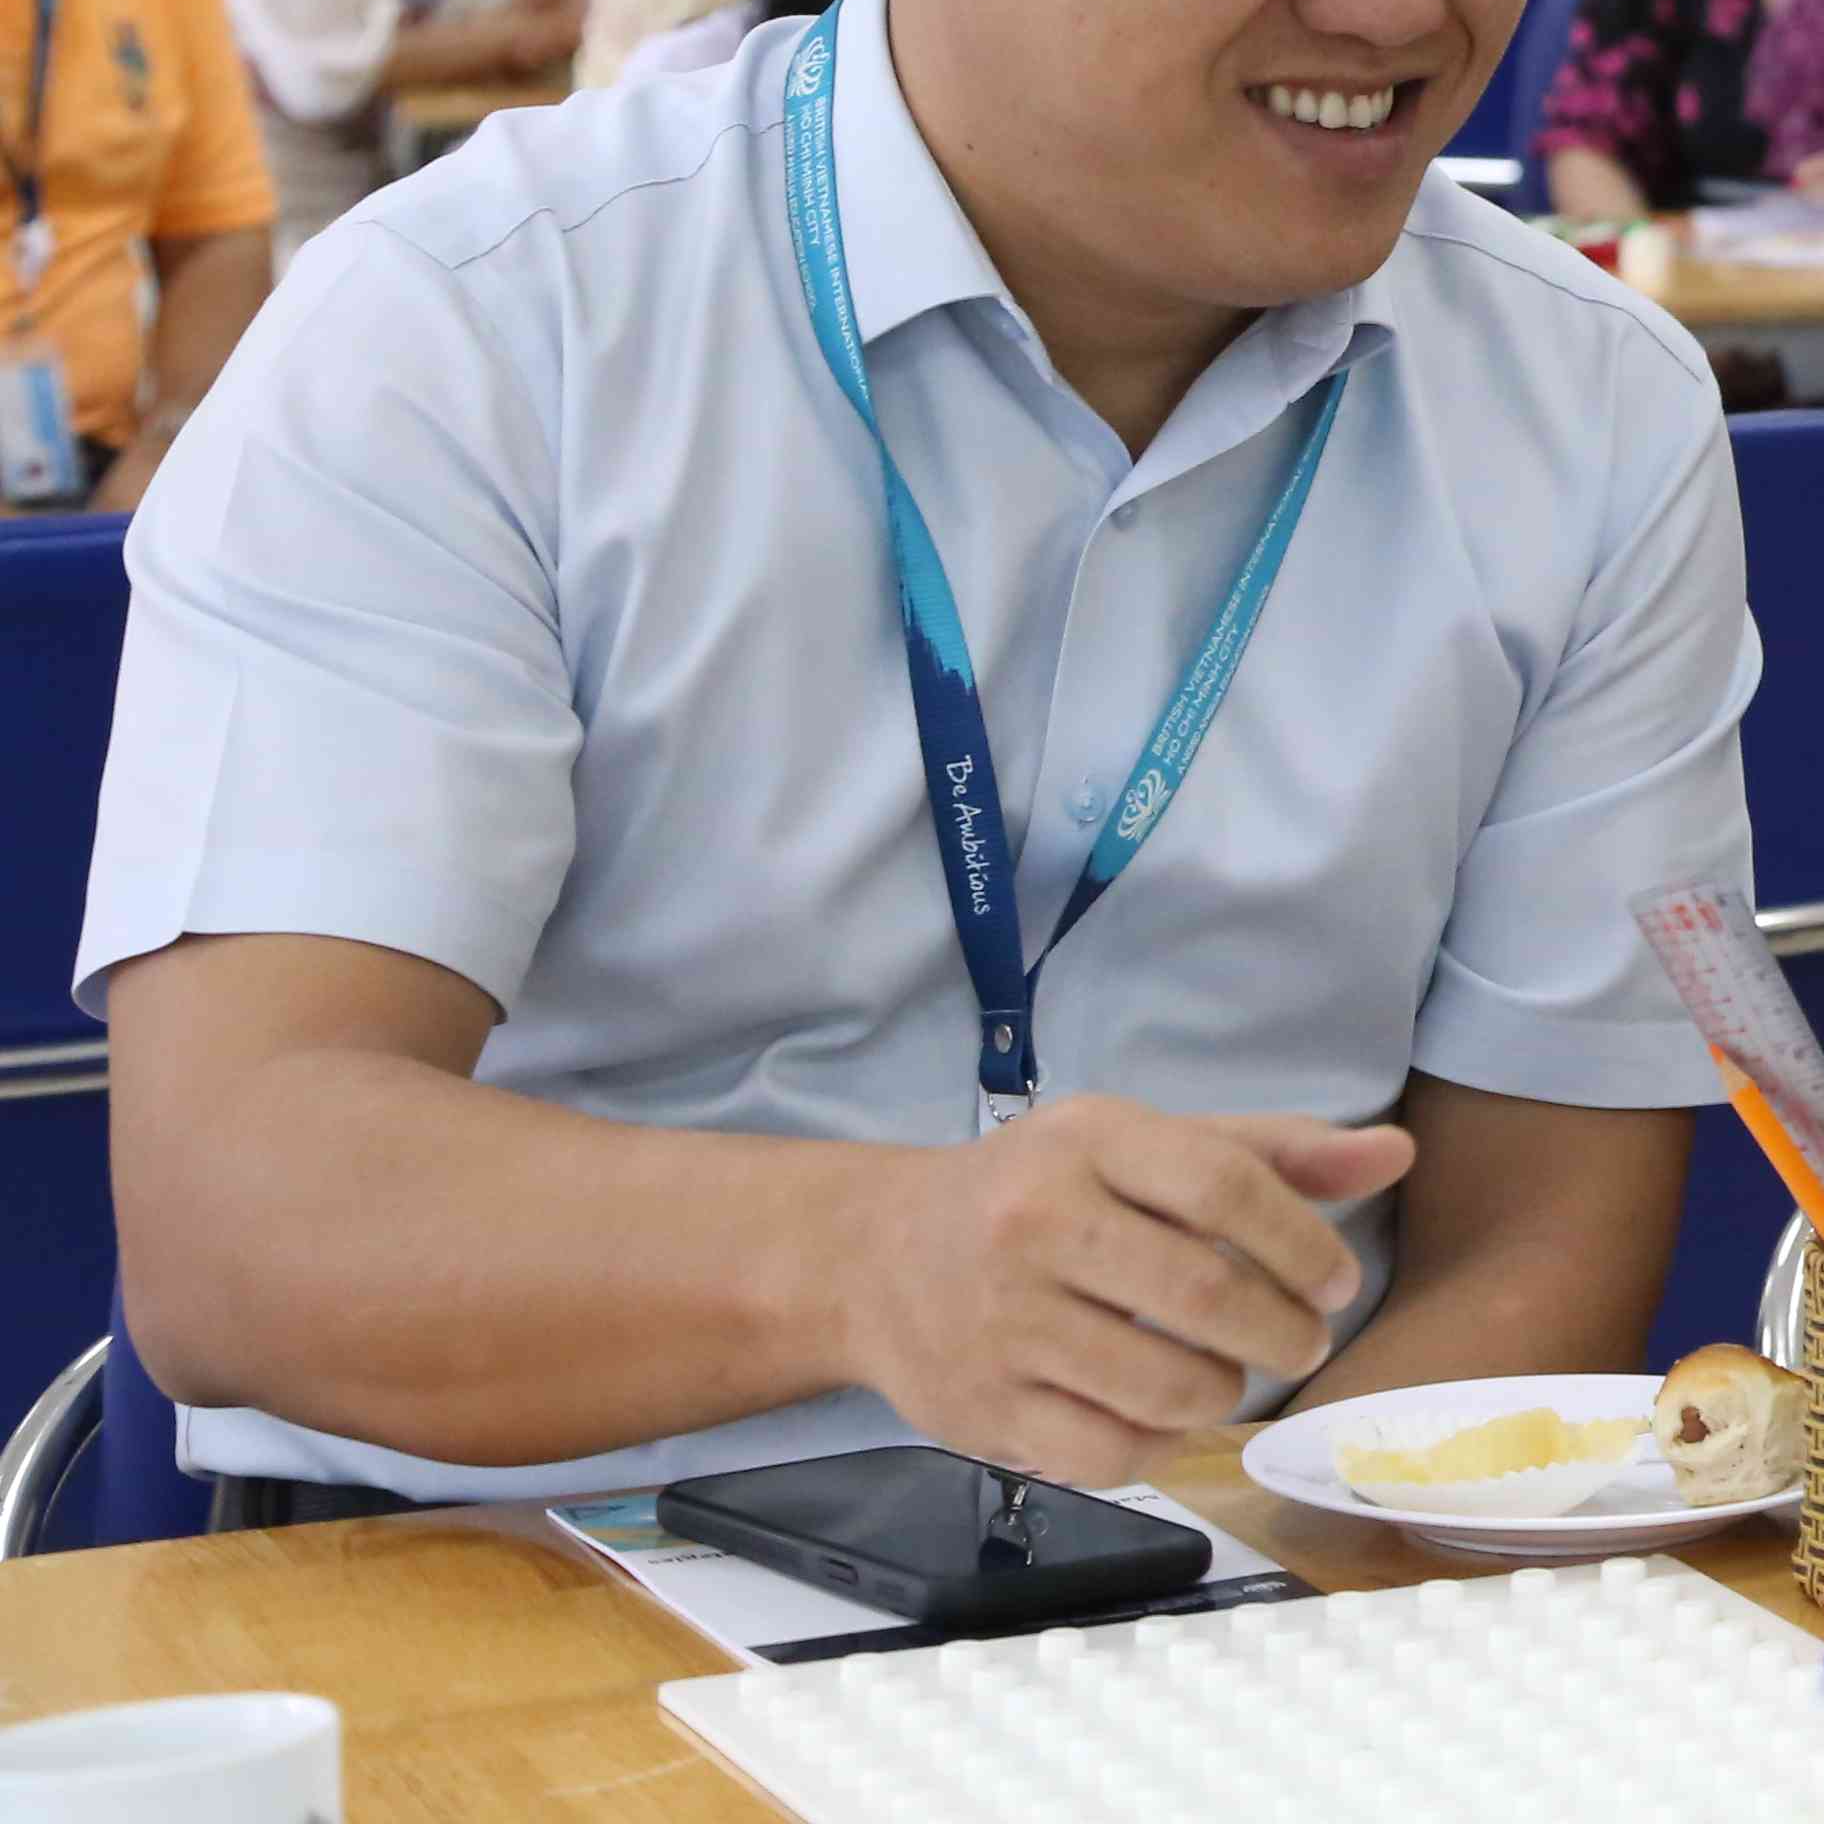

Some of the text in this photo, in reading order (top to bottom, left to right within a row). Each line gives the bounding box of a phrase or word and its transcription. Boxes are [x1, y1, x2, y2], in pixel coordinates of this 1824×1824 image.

[800, 100, 813, 129] HO
[800, 132, 813, 161] CHI
[800, 163, 815, 208] MINH
[816, 157, 837, 264] VIETNAMESE
[804, 210, 820, 245] CITY
[1151, 694, 1189, 757] BRITISH
[1183, 591, 1243, 693] VIETNAMESE
[1163, 738, 1181, 767] HO
[1193, 663, 1222, 709] MINH
[1218, 624, 1240, 662] CITY
[946, 754, 991, 915] Be Ambitious
